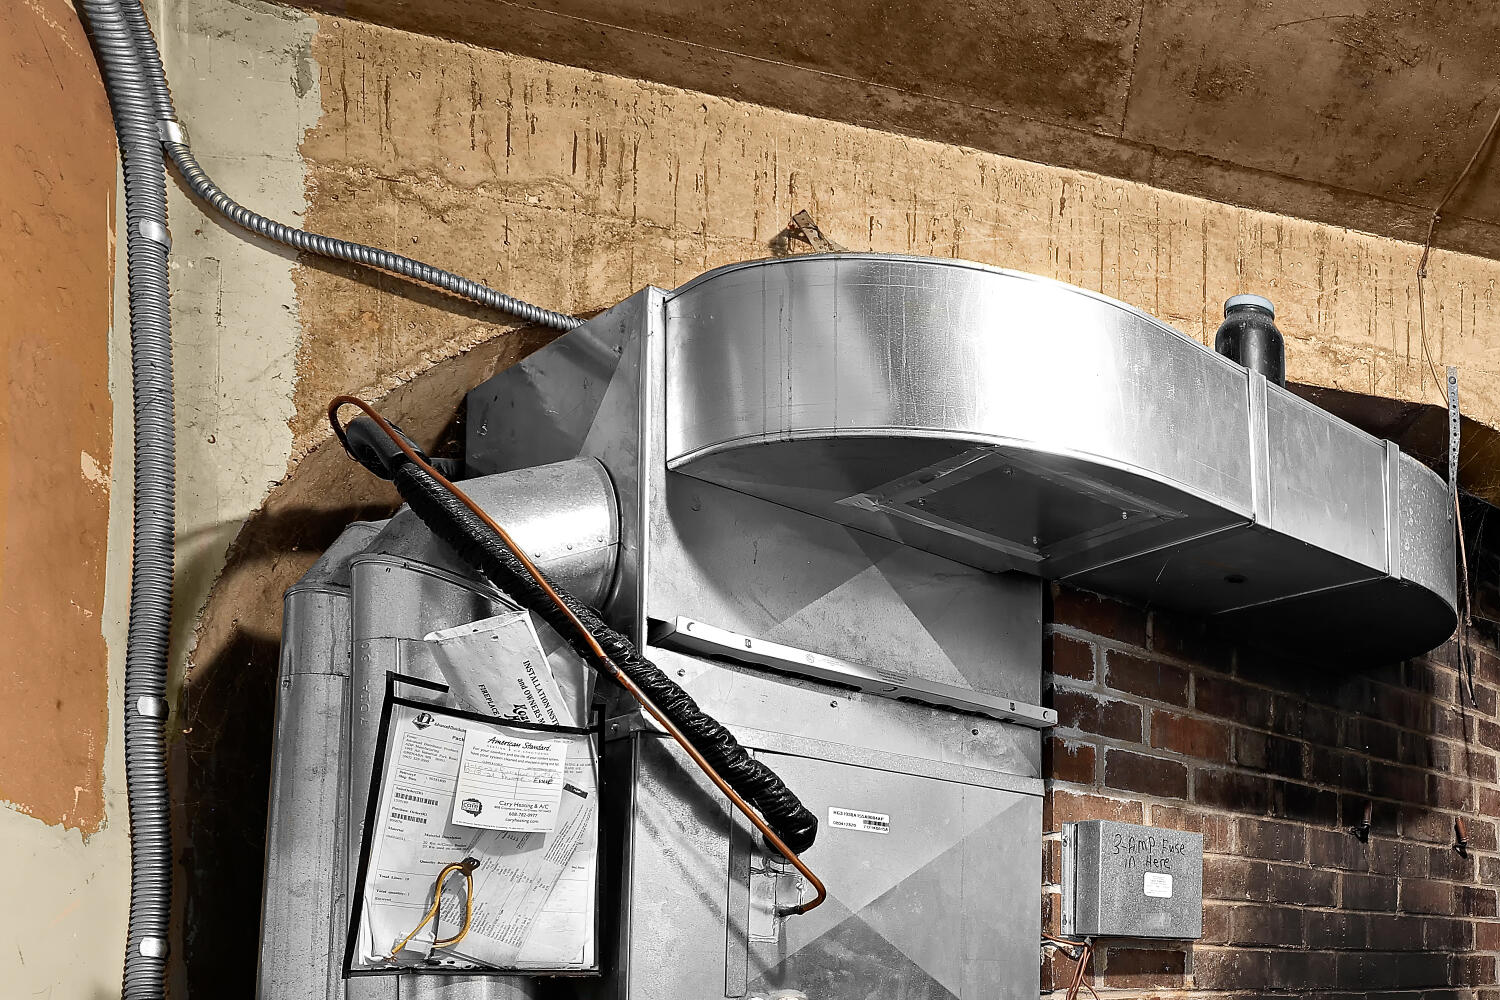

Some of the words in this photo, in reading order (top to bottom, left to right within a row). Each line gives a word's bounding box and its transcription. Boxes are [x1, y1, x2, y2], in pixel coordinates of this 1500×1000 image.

[523, 660, 550, 708] INSTALLATION
[478, 683, 500, 716] FIREPLACE
[517, 678, 527, 690] and
[524, 689, 543, 719] OWNERS
[488, 736, 521, 748] American
[522, 742, 551, 751] Standard
[1162, 838, 1185, 856] Fuse
[1145, 855, 1171, 869] Here
